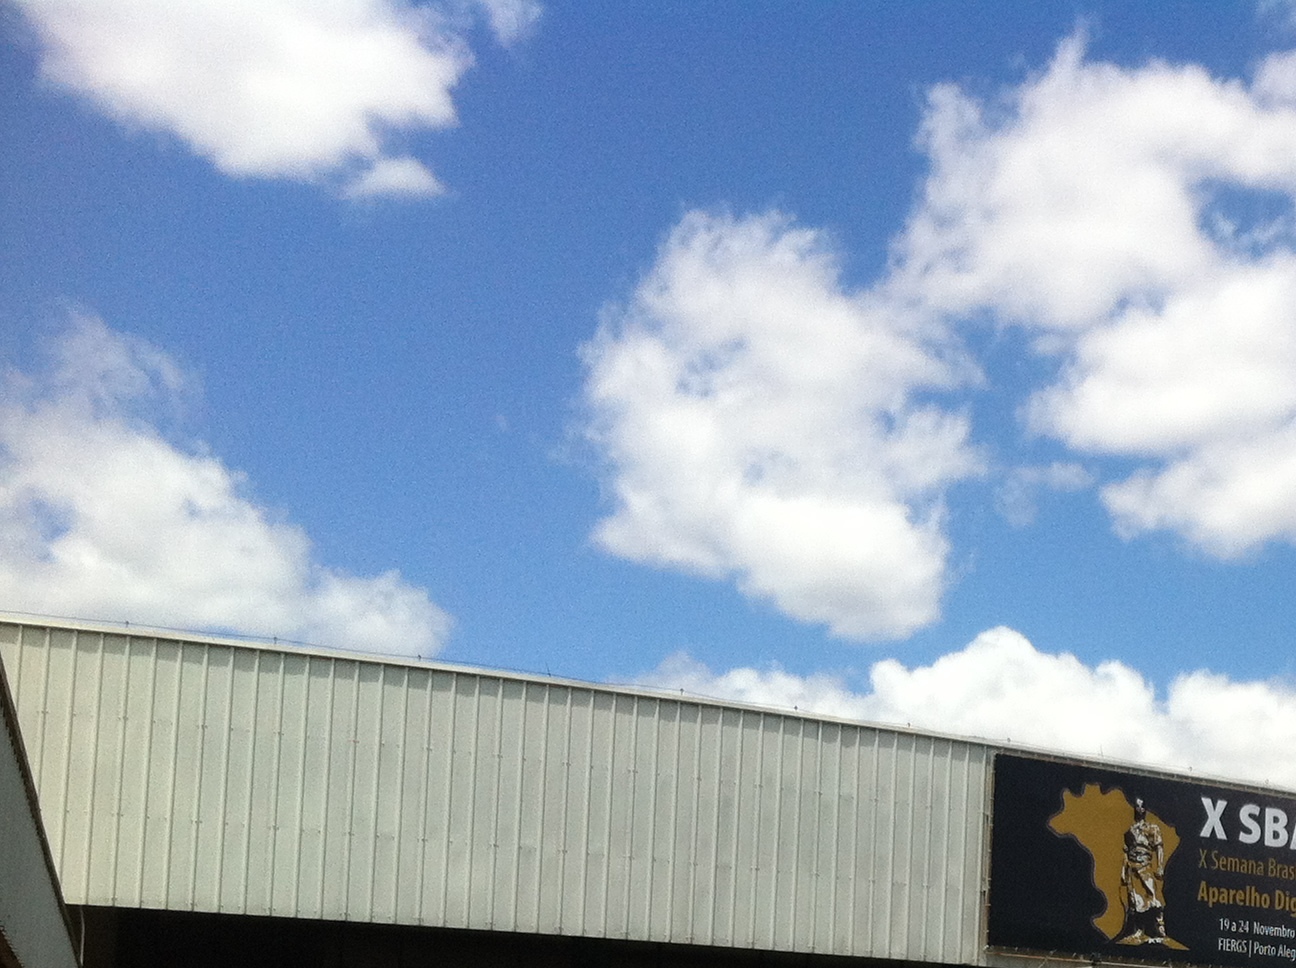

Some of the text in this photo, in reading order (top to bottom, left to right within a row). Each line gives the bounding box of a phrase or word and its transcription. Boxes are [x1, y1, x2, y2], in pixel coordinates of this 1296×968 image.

[1200, 797, 1228, 840] X
[1198, 848, 1208, 869] X
[1211, 850, 1264, 876] Semana
[1197, 880, 1271, 909] Aparelho
[1219, 918, 1230, 931] 19
[1231, 921, 1237, 932] a
[1238, 920, 1250, 933] 24
[1253, 921, 1296, 938] Novembro
[1218, 937, 1248, 953] FIERGS
[1253, 941, 1277, 957] Porto
